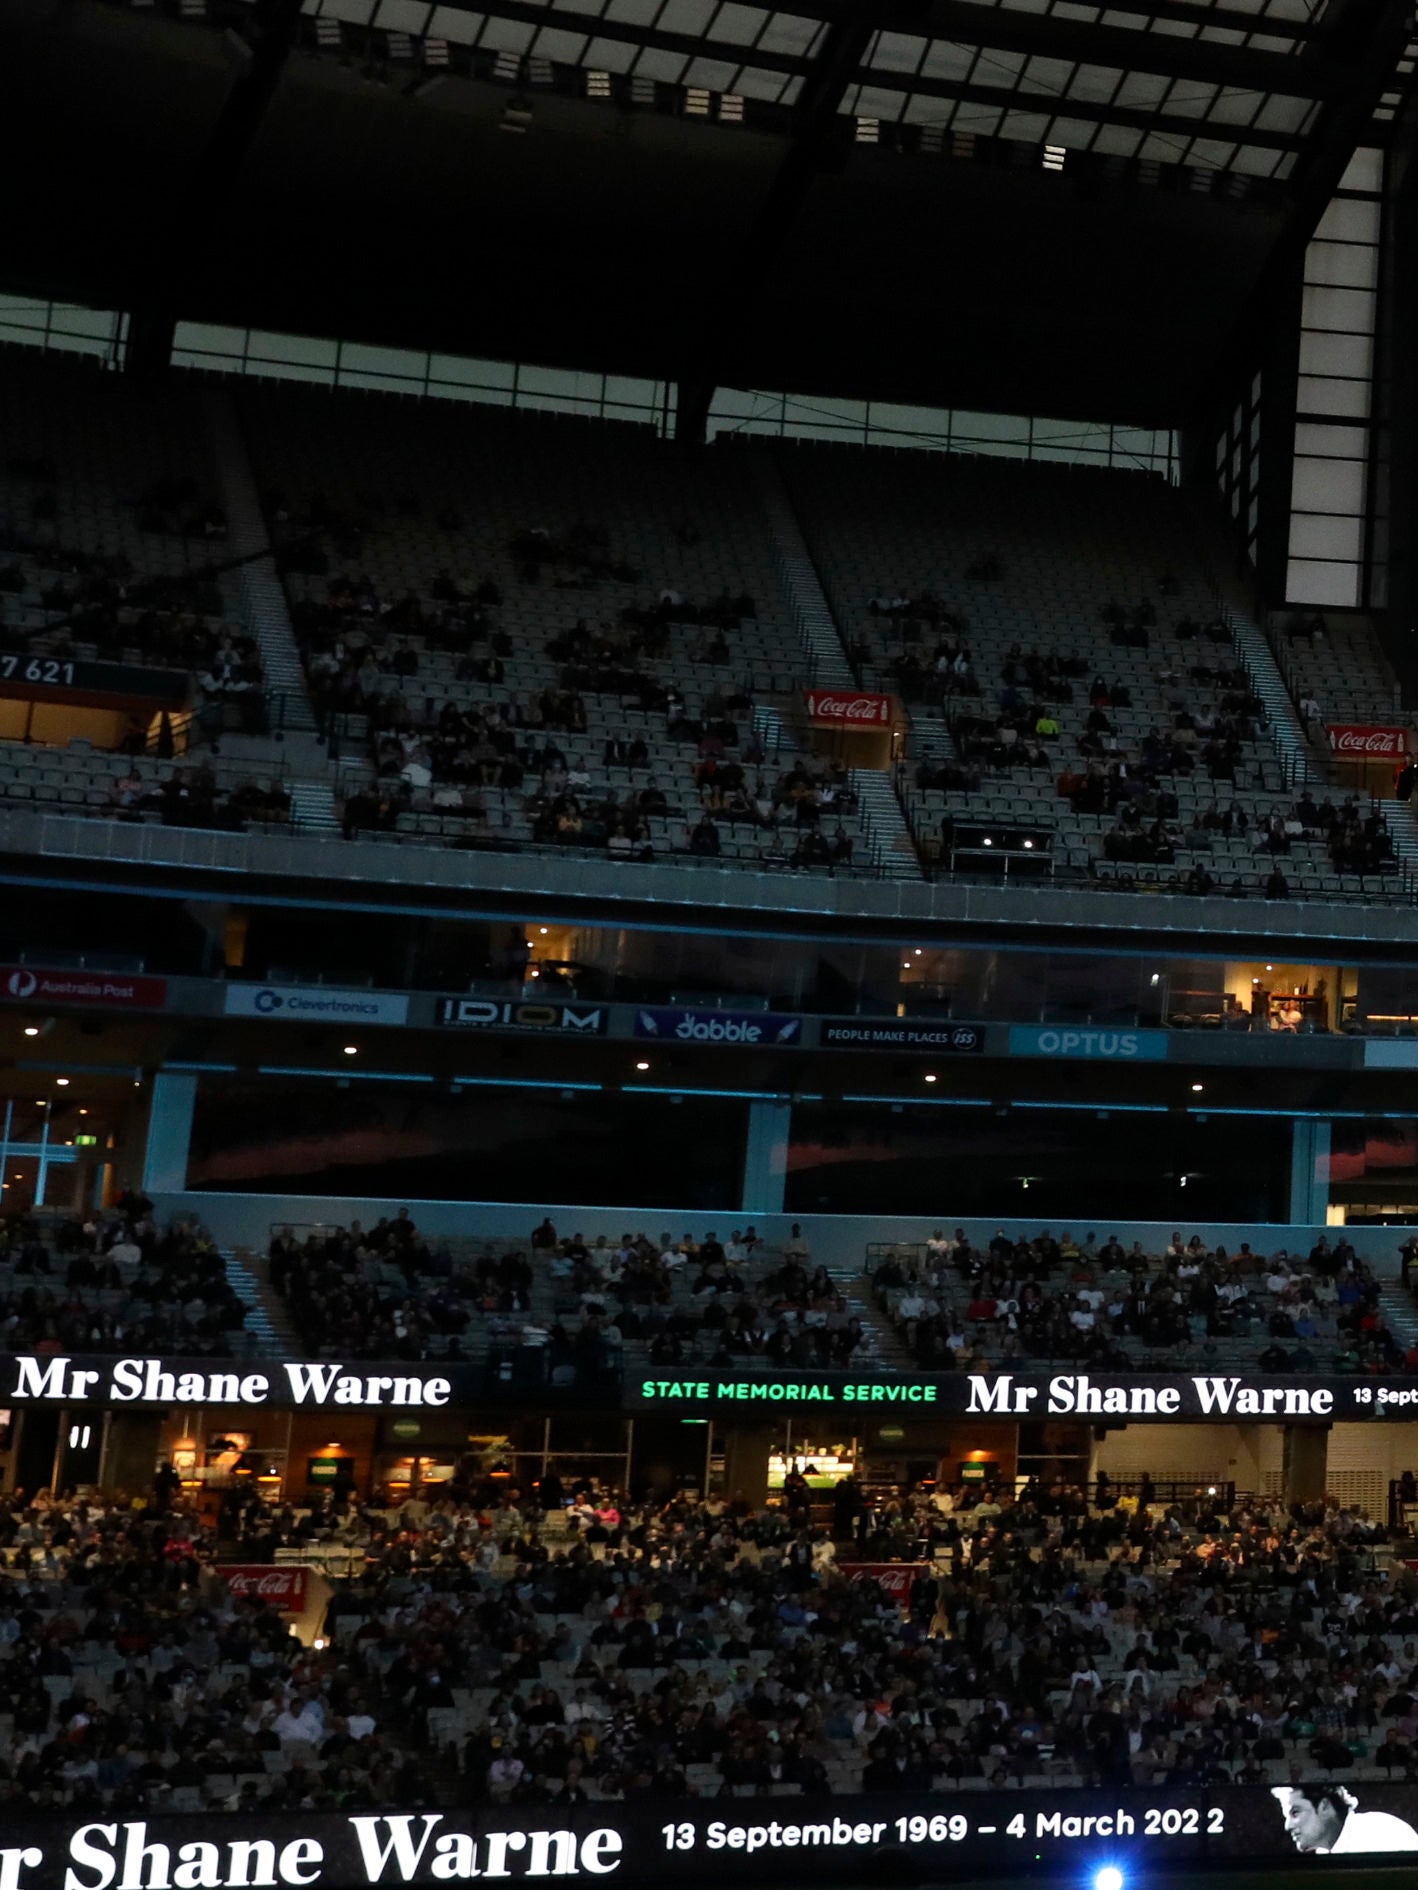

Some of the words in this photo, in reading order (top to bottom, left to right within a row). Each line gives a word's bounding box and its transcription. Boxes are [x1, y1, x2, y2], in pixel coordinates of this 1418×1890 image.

[0, 655, 18, 679] 7
[26, 659, 75, 685] 621
[817, 696, 879, 719] Coca-Cola
[1338, 731, 1396, 752] Coca-Cola
[40, 978, 101, 997] Australia
[104, 983, 134, 999] Post
[287, 996, 380, 1016] Clevertronics
[443, 1000, 601, 1029] IDIOM
[675, 1013, 762, 1042] dabble
[827, 1028, 871, 1041] PEOPLE
[873, 1030, 905, 1042] MAKE
[908, 1031, 948, 1044] PLACES
[1037, 1031, 1139, 1056] OPTUS
[11, 1356, 99, 1399] Mr
[111, 1359, 268, 1402] Shane
[283, 1363, 451, 1406] Warne
[642, 1381, 710, 1399] STATE
[717, 1383, 835, 1401] MEMORIAL
[842, 1384, 937, 1402] SERVICE
[965, 1375, 1038, 1413] Mr
[1047, 1375, 1181, 1414] Shane
[1191, 1377, 1334, 1415] Warne
[1353, 1387, 1372, 1404] 13
[662, 1822, 696, 1850] 13
[706, 1817, 887, 1851] September
[895, 1815, 968, 1843] 1969
[1005, 1812, 1027, 1839] 4
[1036, 1808, 1135, 1838] March
[1144, 1808, 1224, 1835] 2022
[65, 1821, 324, 1890] Shane
[348, 1813, 624, 1883] Warne
